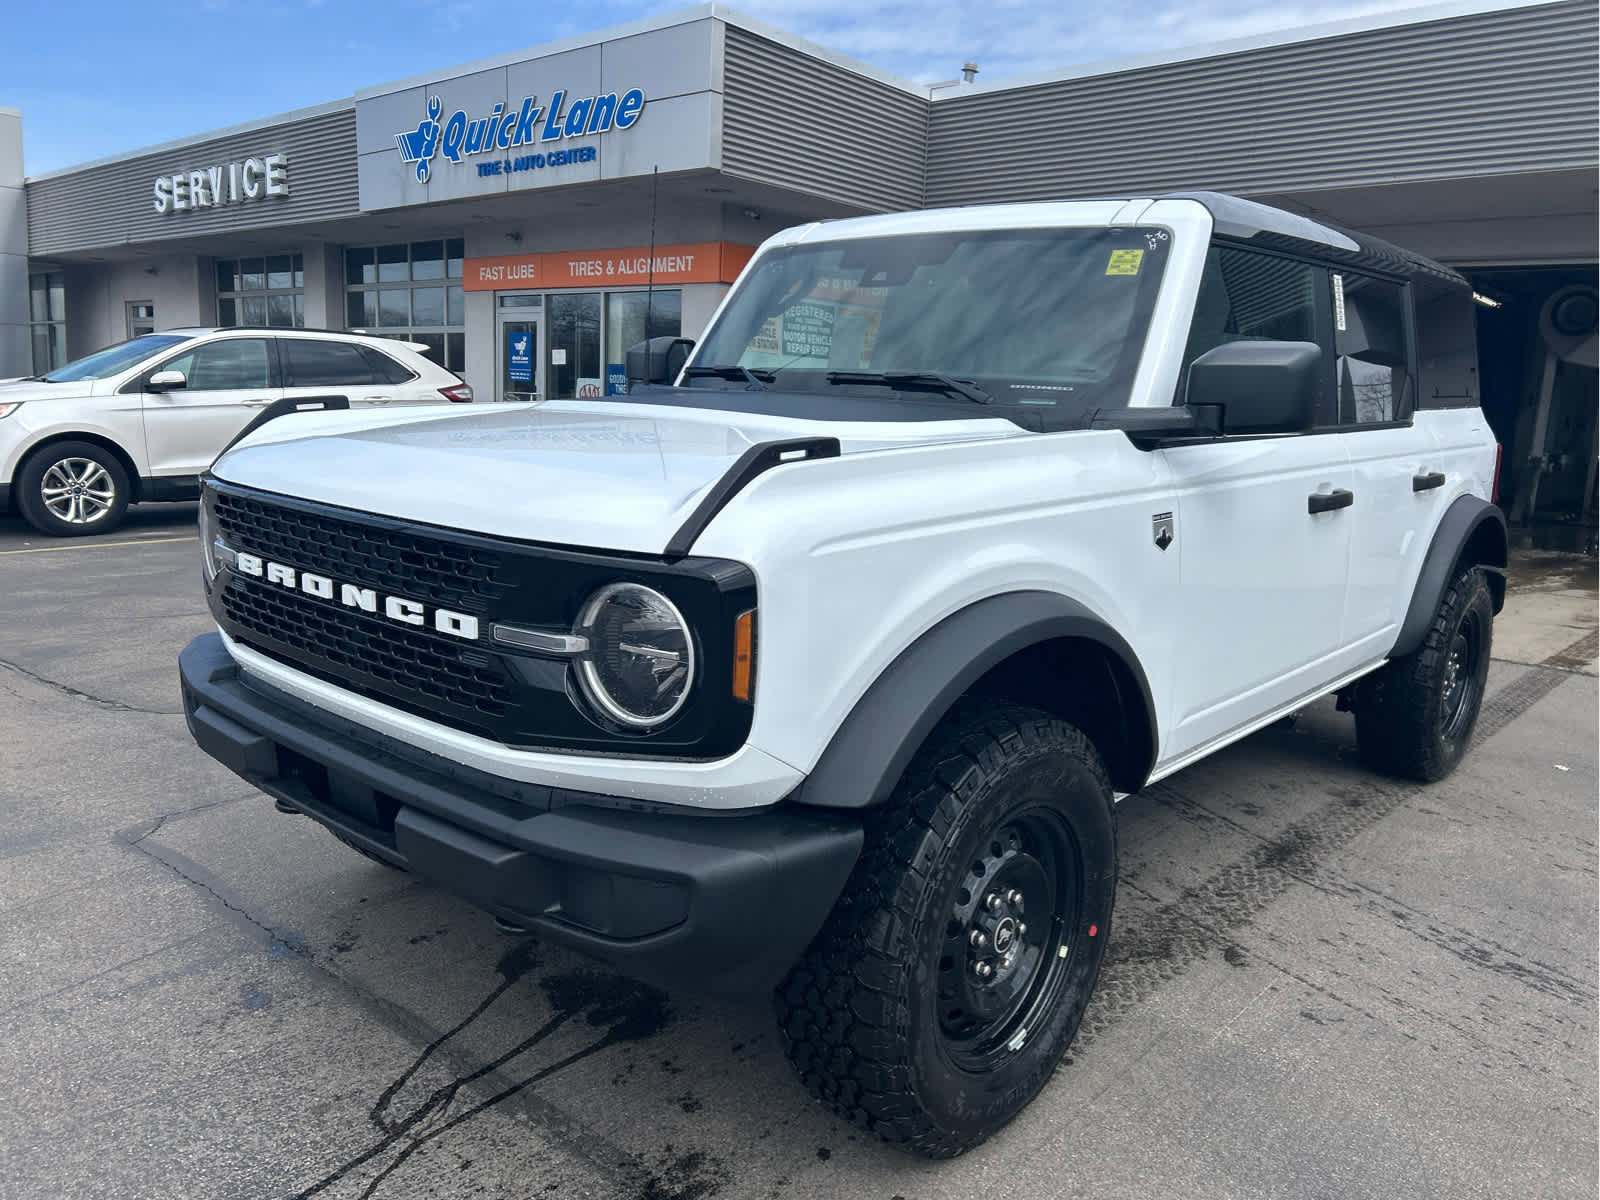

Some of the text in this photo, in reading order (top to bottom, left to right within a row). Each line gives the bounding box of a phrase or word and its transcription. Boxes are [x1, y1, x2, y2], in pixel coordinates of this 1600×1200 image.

[442, 88, 645, 164] Quick Lane
[476, 146, 596, 178] TIRE & AUTO CENTER
[153, 153, 288, 214] SERVICE
[479, 263, 535, 281] FAST LUBE
[568, 255, 694, 277] TIRES & ALIGNMENT
[784, 331, 833, 346] MOTOR VEHICLE
[786, 341, 830, 355] REPAIR SHOP
[238, 551, 479, 640] BRONCO
